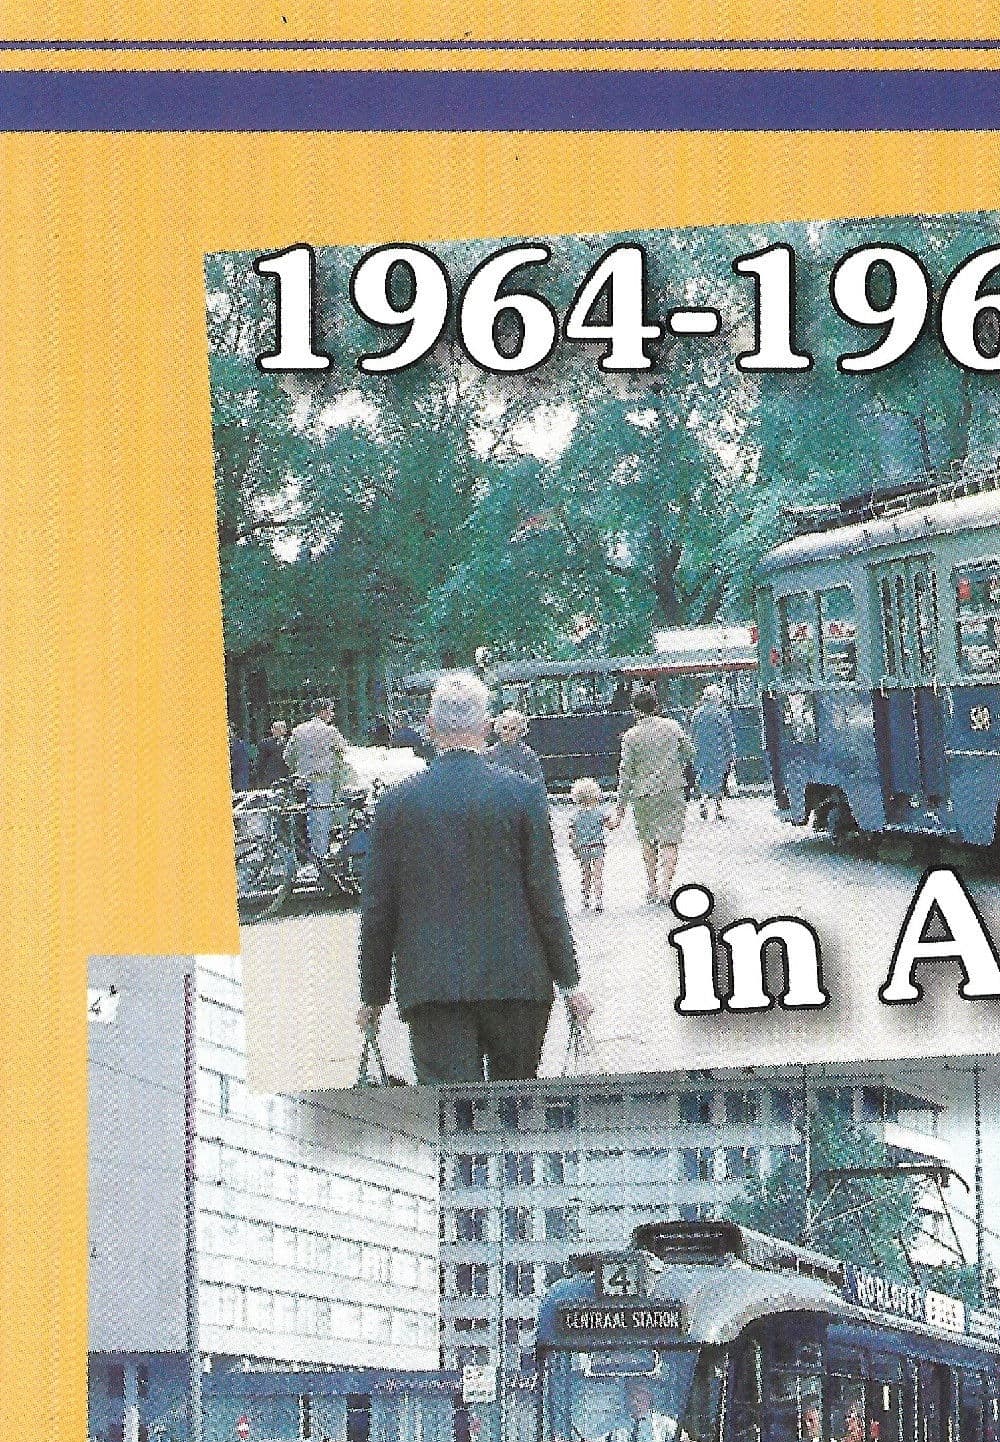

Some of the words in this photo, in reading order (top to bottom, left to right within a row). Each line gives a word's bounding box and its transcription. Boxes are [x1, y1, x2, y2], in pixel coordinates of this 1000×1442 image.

[608, 1265, 631, 1293] 4
[565, 1309, 628, 1330] CENTRAAL
[632, 1310, 680, 1330] STATION
